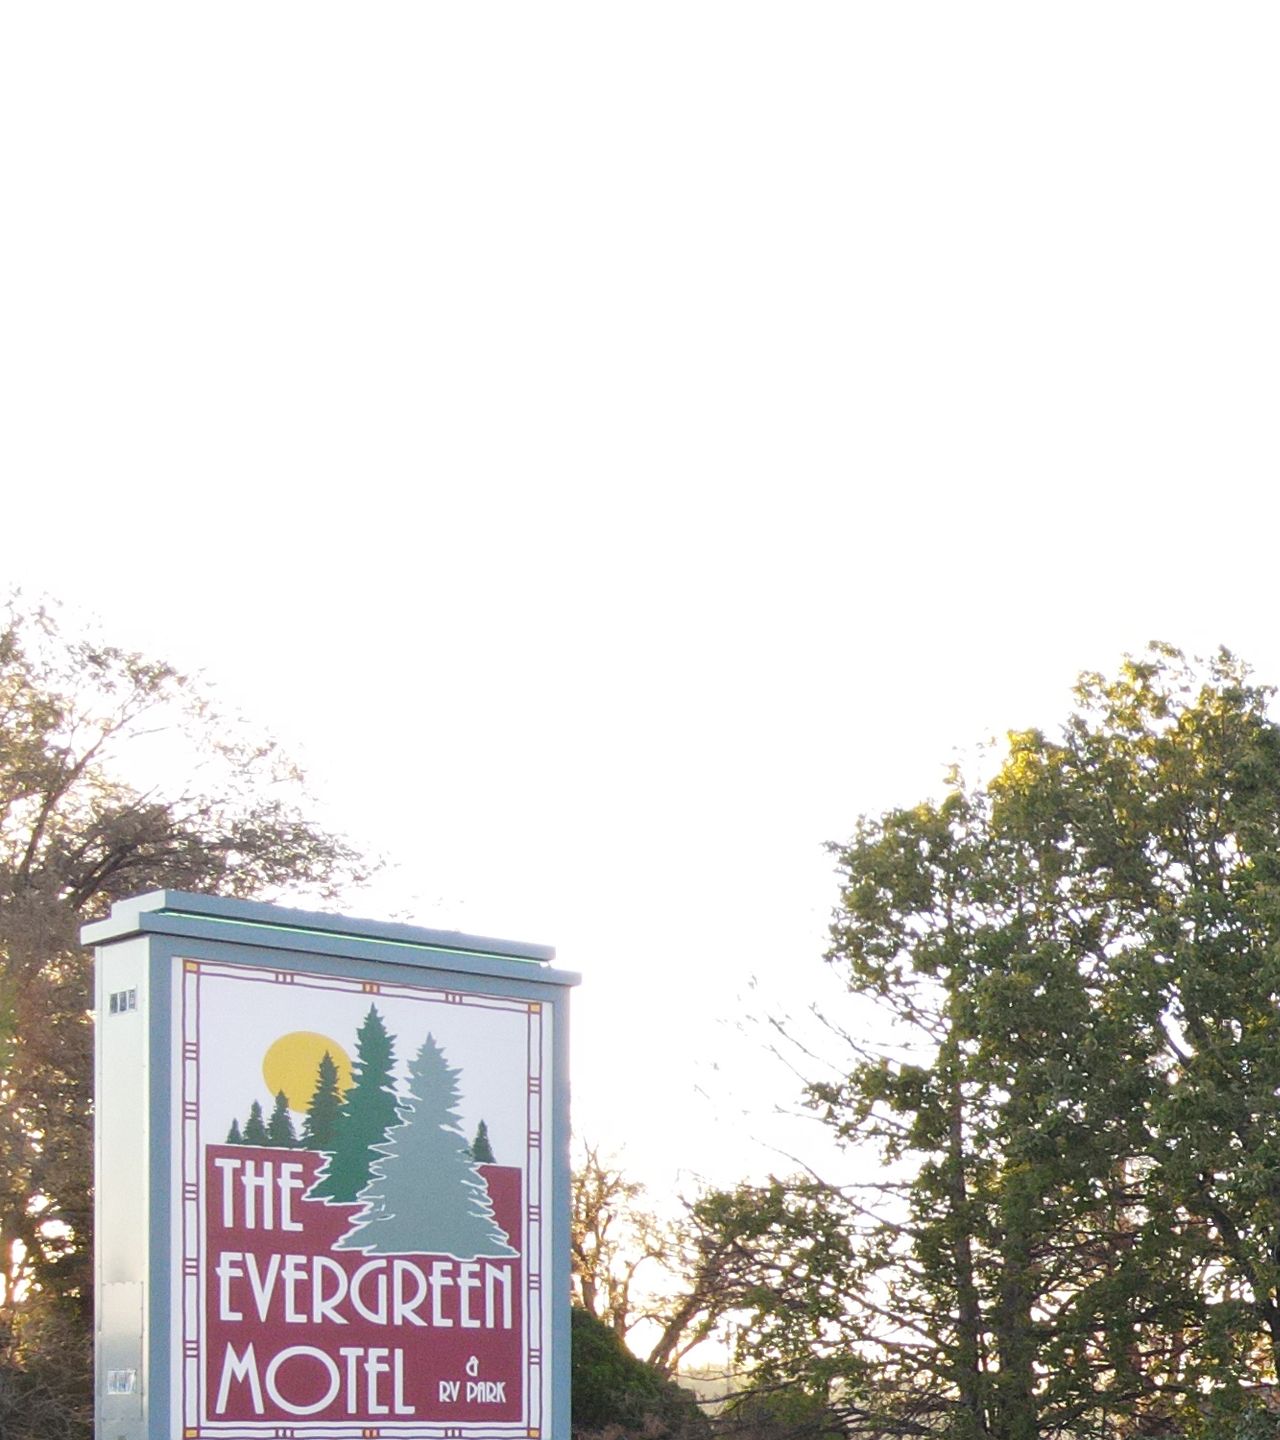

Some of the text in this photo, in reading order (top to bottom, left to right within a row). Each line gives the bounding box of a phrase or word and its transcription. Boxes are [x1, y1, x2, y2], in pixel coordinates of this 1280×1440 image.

[214, 1157, 304, 1232] THE
[215, 1251, 513, 1330] EVERGREEN
[214, 1341, 416, 1417] MOTEL
[439, 1380, 506, 1404] RV PARK
